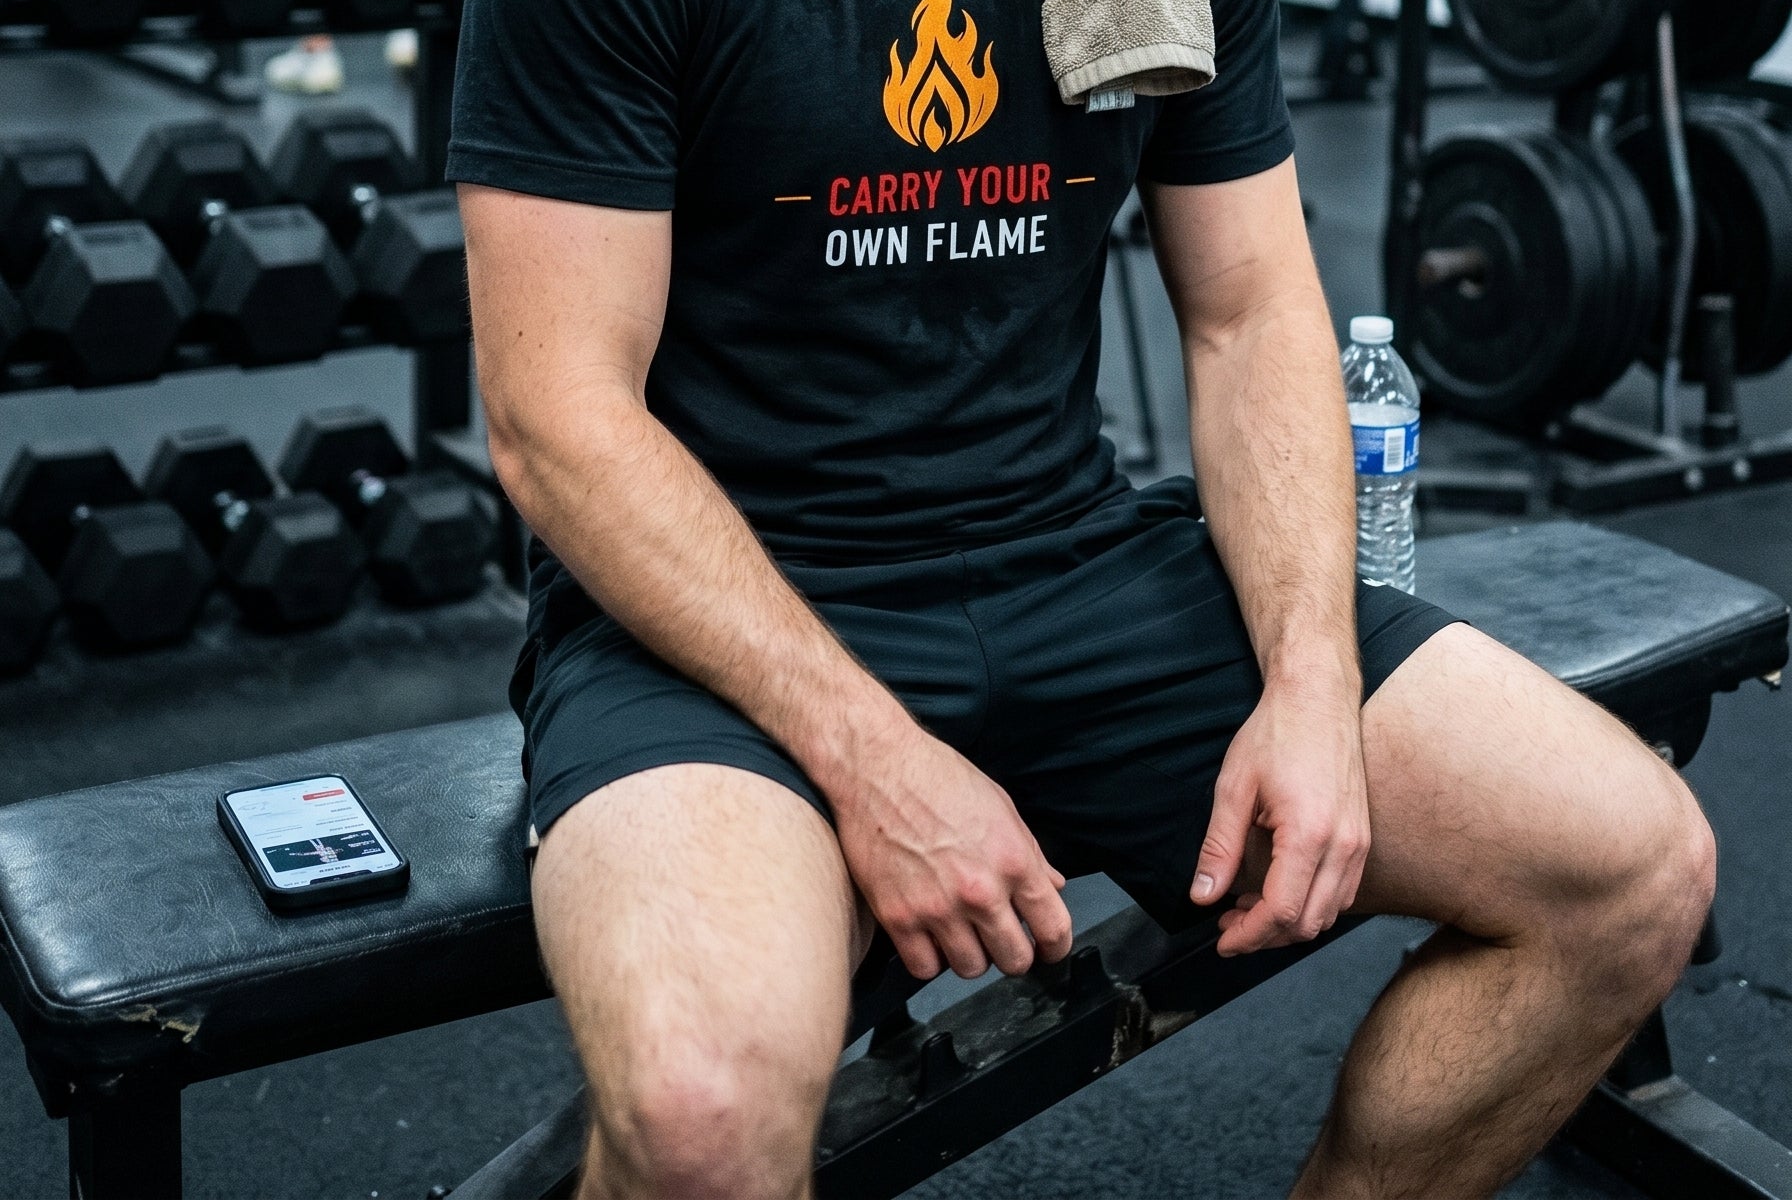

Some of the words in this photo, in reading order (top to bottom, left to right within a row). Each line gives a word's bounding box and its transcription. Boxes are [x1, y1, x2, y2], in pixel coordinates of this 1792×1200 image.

[829, 169, 943, 216] CARRY
[957, 163, 1050, 206] YOUR
[825, 226, 908, 267] OWN
[926, 214, 1048, 261] FLAME
